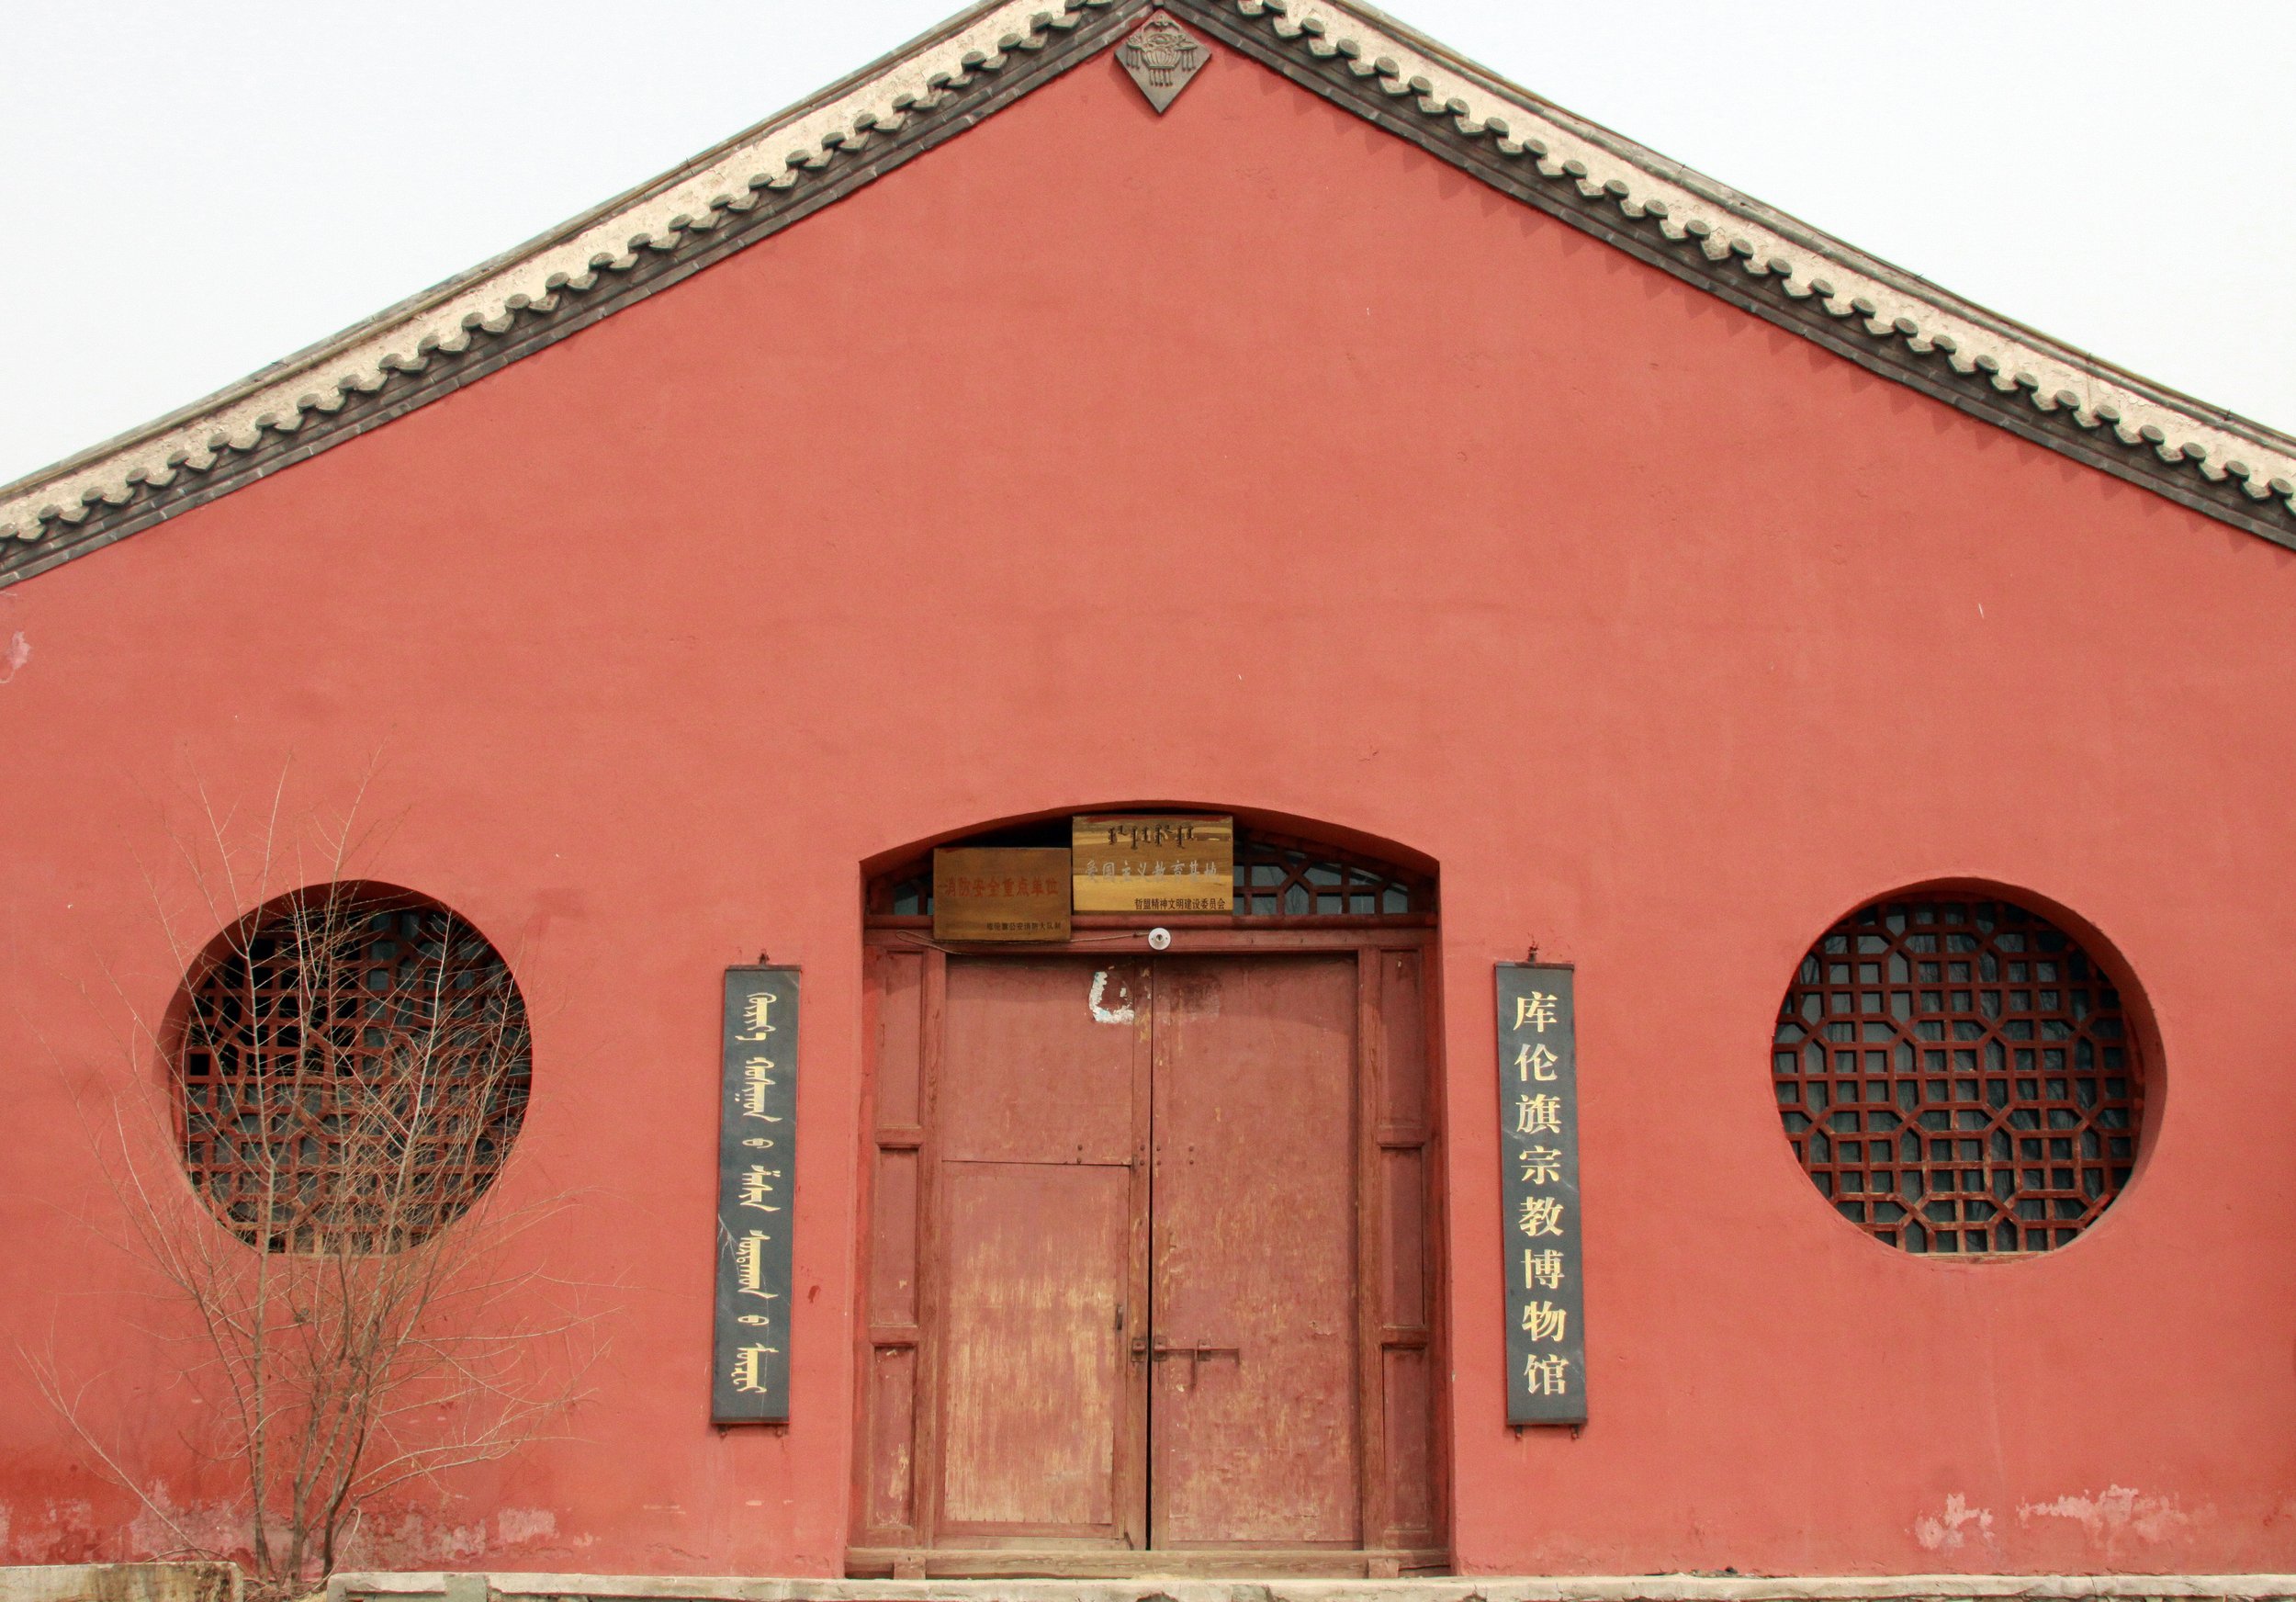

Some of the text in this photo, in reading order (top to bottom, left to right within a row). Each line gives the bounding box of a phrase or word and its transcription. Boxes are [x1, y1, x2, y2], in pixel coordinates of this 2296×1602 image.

[1134, 897, 1226, 910] 哲盟精神文明建设委员会
[1513, 990, 1568, 1397] 库伦旗宗教博物馆
